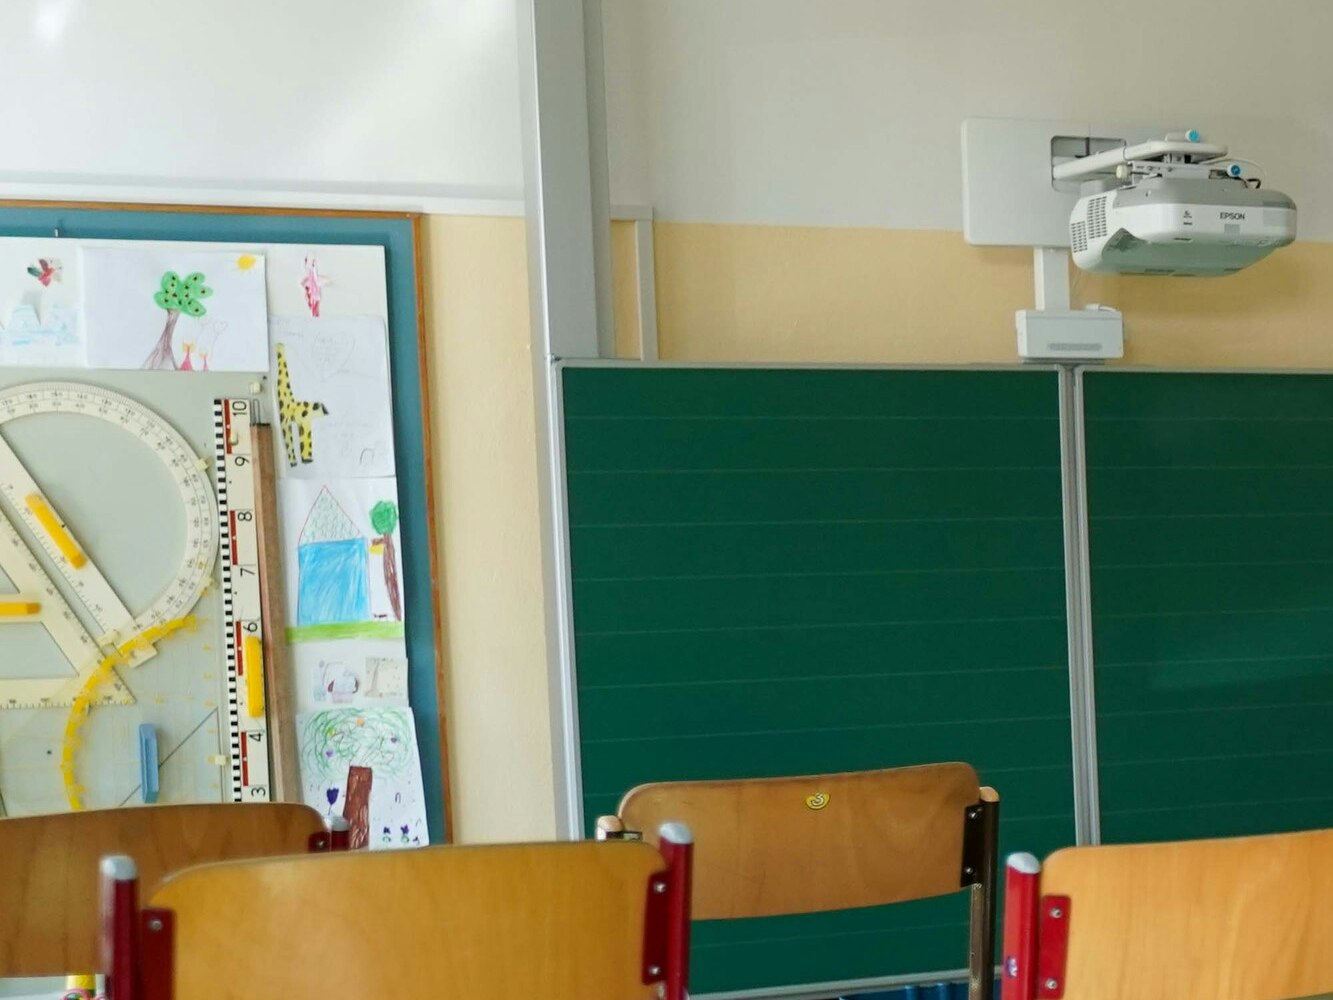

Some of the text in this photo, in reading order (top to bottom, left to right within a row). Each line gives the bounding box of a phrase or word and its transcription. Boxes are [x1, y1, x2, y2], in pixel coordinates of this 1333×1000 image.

[1220, 211, 1246, 221] EPSON
[232, 401, 247, 416] 10
[234, 456, 250, 467] 9
[237, 511, 253, 522] 8
[240, 567, 255, 577] 7
[242, 622, 258, 632] 6
[249, 732, 264, 742] 4
[251, 786, 266, 797] 3
[811, 792, 825, 805] 3
